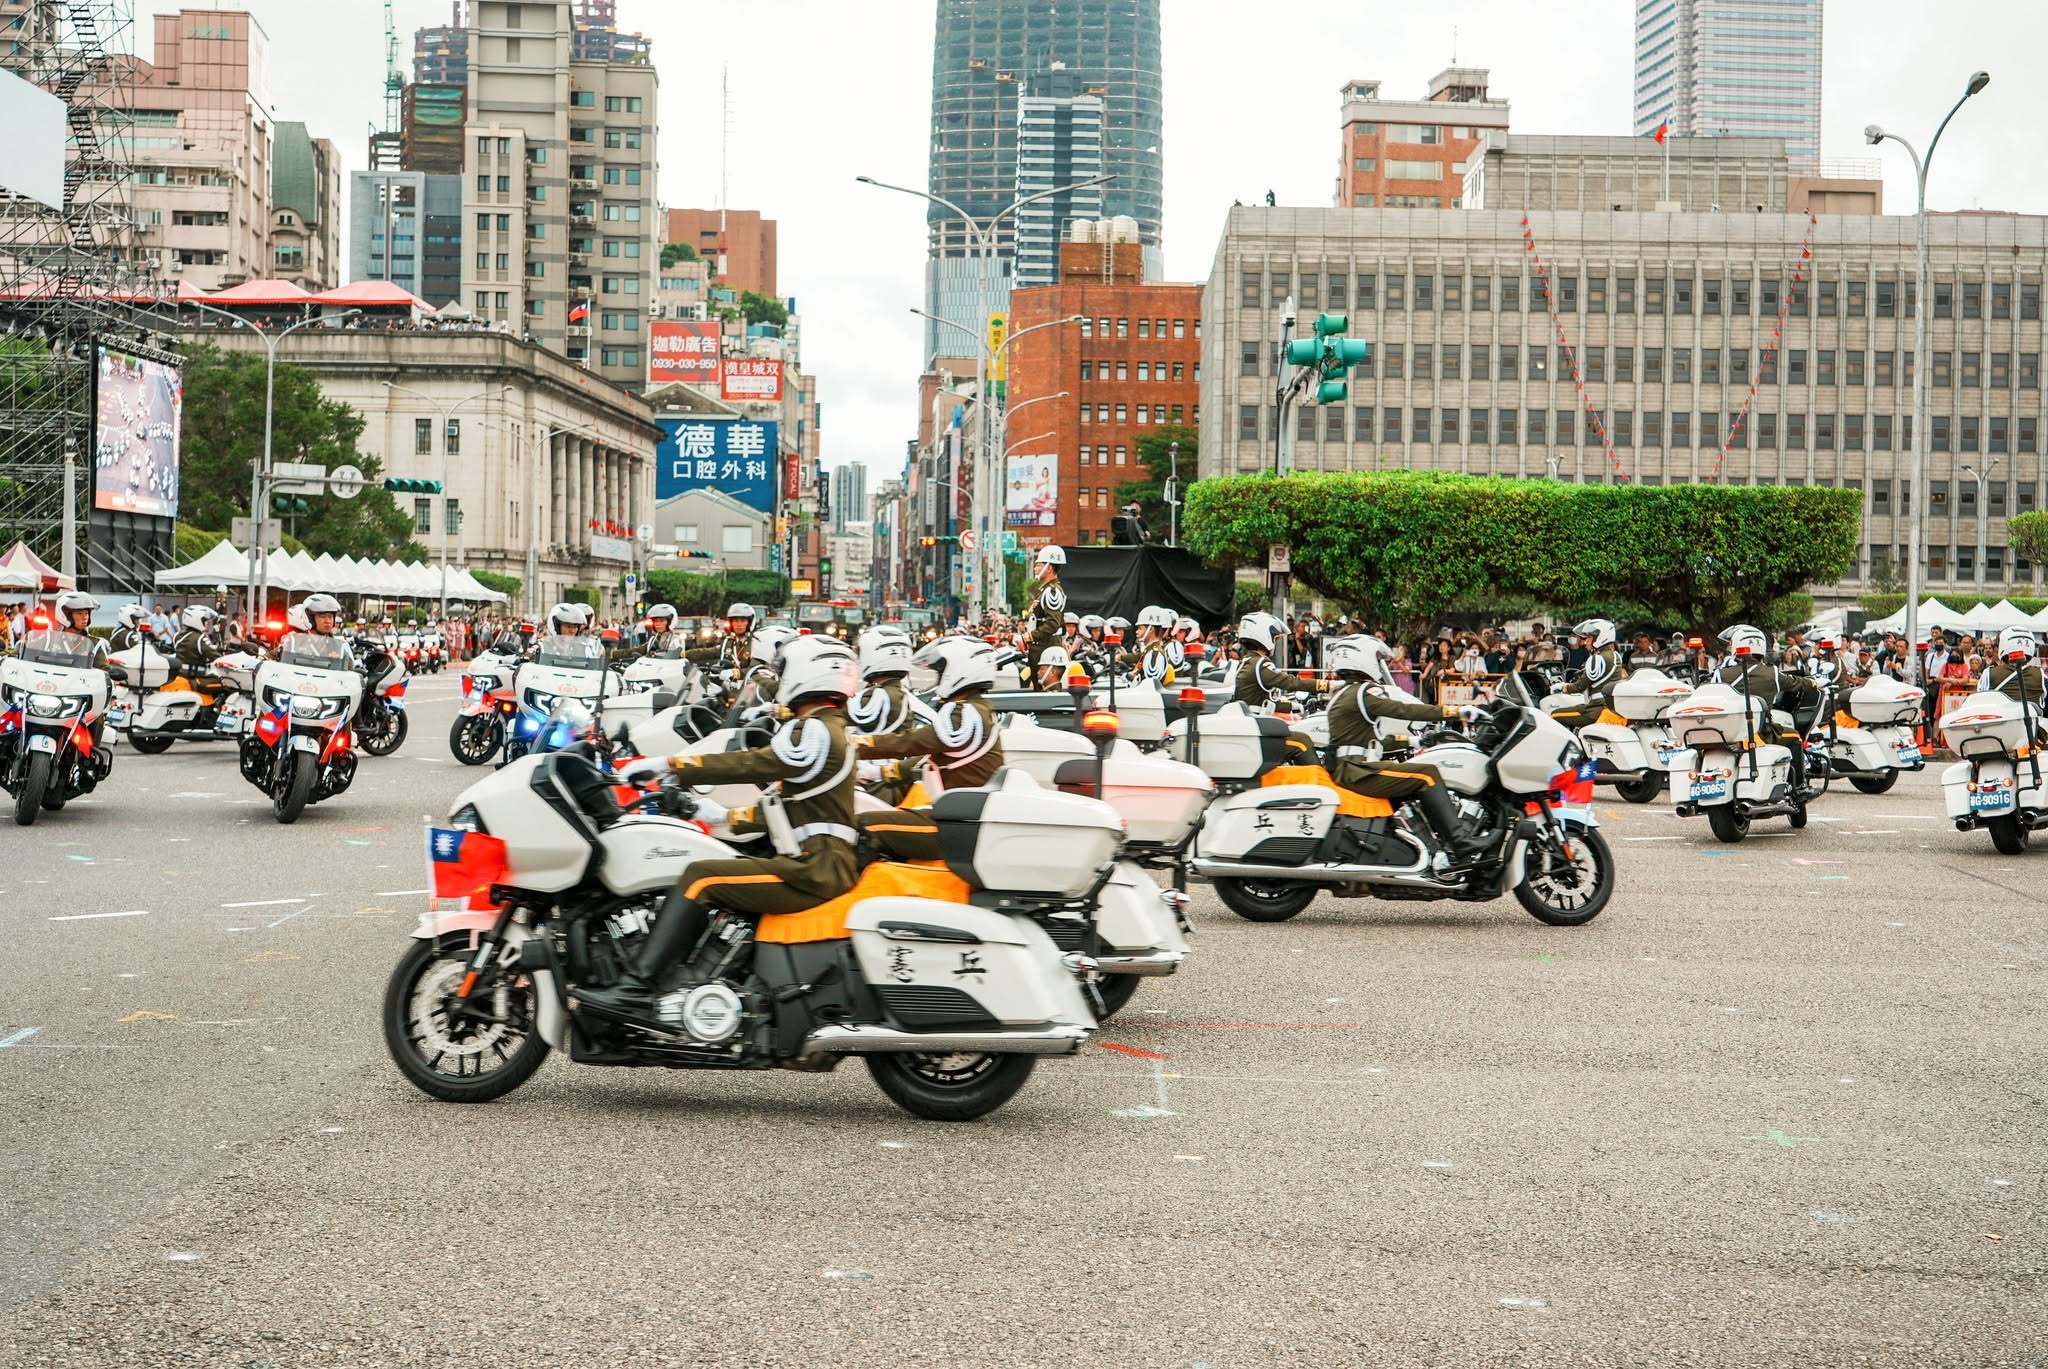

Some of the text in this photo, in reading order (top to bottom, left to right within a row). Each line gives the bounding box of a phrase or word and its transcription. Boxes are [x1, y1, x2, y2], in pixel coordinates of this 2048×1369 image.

[674, 423, 766, 458] 德華
[672, 460, 767, 480] 口腔外科
